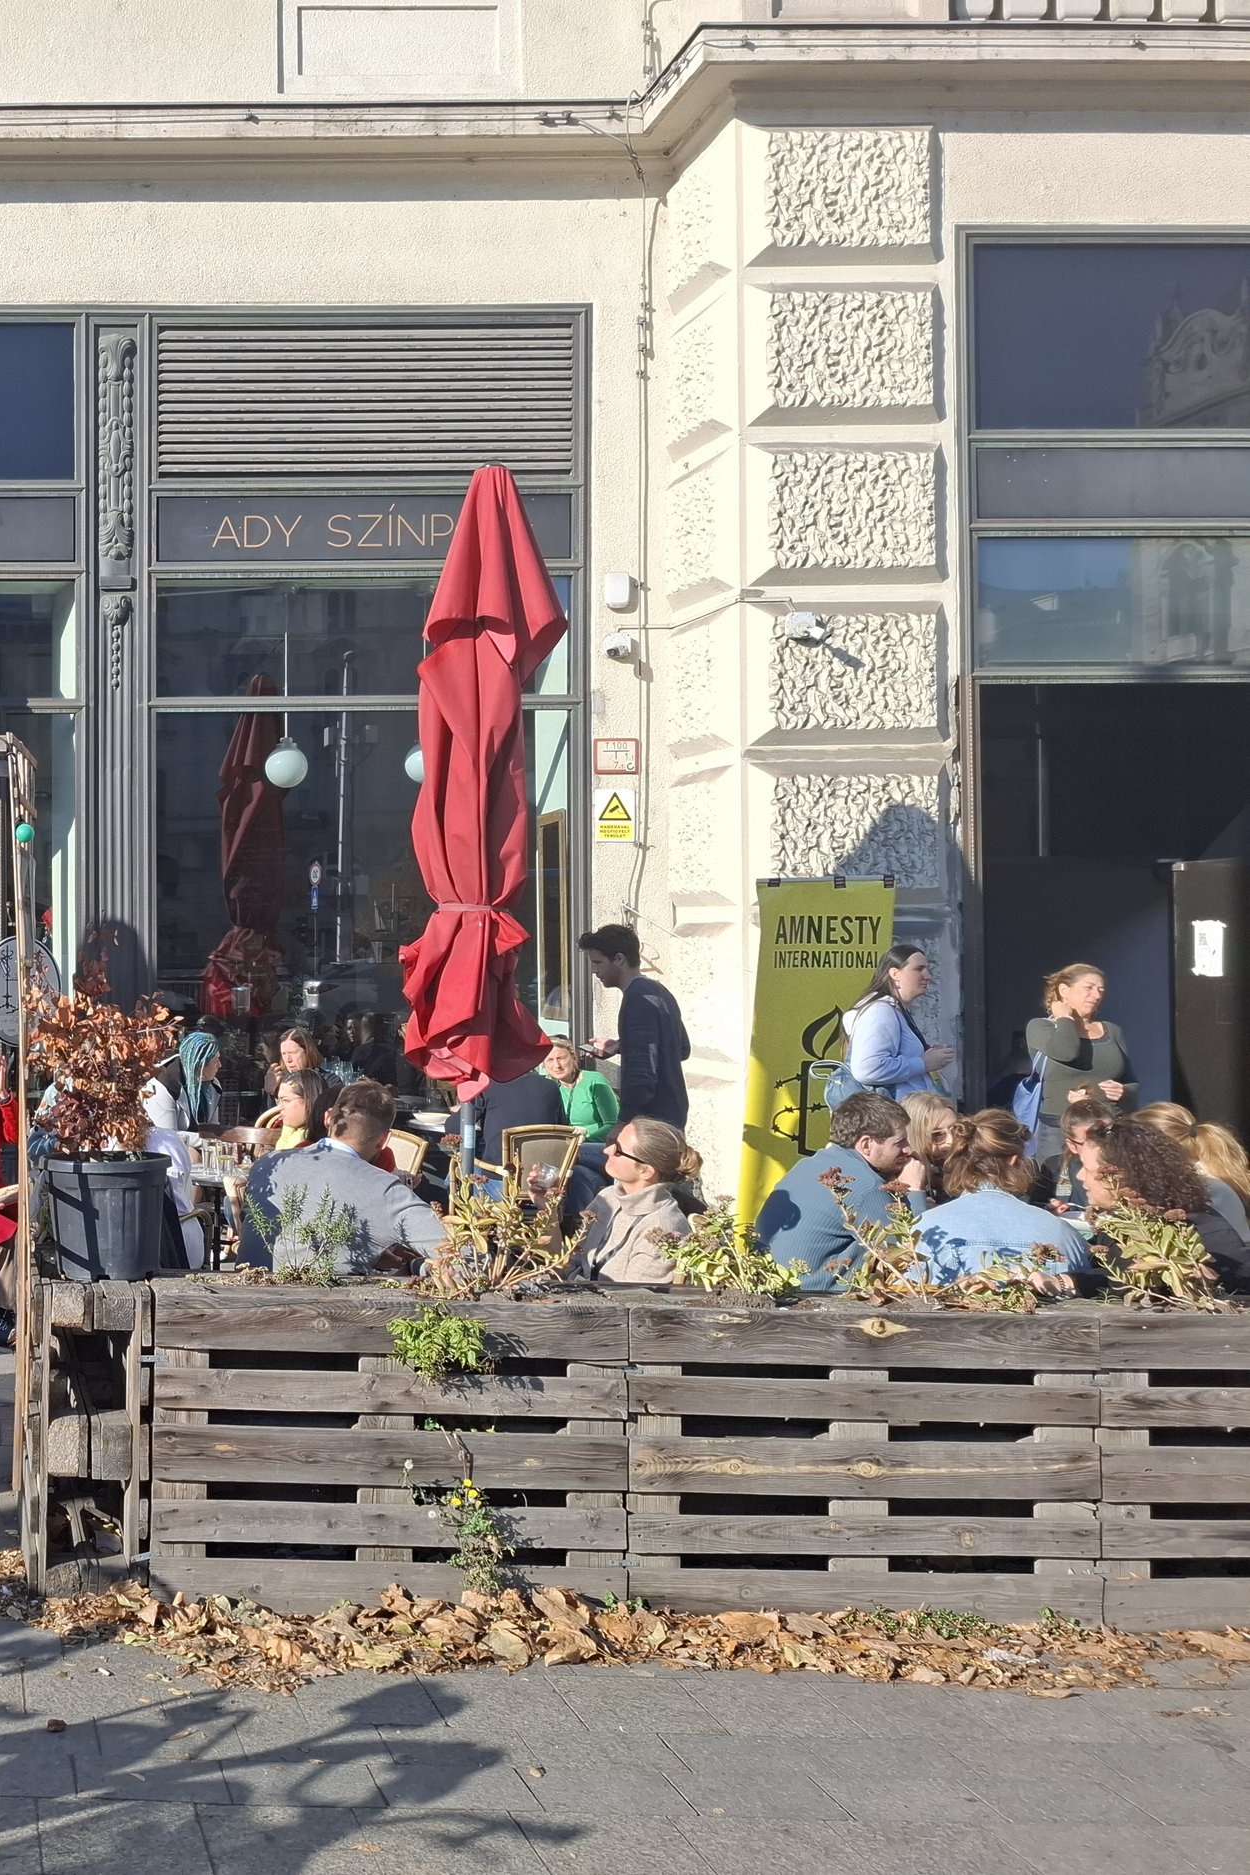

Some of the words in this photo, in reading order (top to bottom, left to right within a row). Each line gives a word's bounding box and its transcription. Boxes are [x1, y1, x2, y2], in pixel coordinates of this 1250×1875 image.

[212, 515, 303, 548] ADY
[326, 503, 455, 548] SZÍNP
[613, 742, 628, 750] 100
[775, 915, 882, 945] AMNESTY
